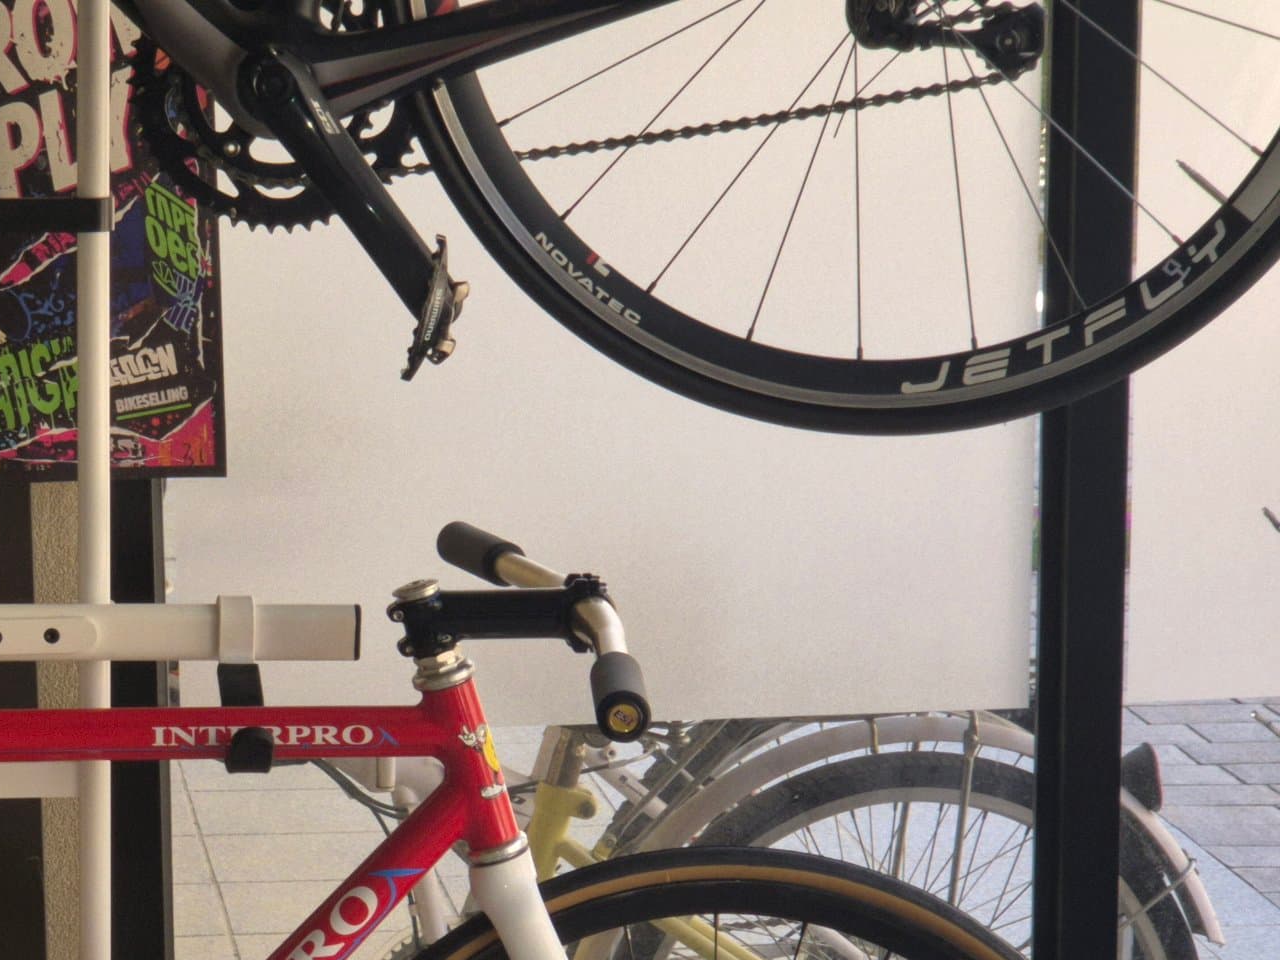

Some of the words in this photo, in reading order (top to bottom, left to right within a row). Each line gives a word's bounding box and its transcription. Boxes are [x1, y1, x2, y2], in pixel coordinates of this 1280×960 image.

[535, 232, 641, 324] NOVATEC
[901, 219, 1226, 394] JETFLY
[115, 386, 189, 413] BIKESELLING
[152, 725, 373, 746] INTPRO
